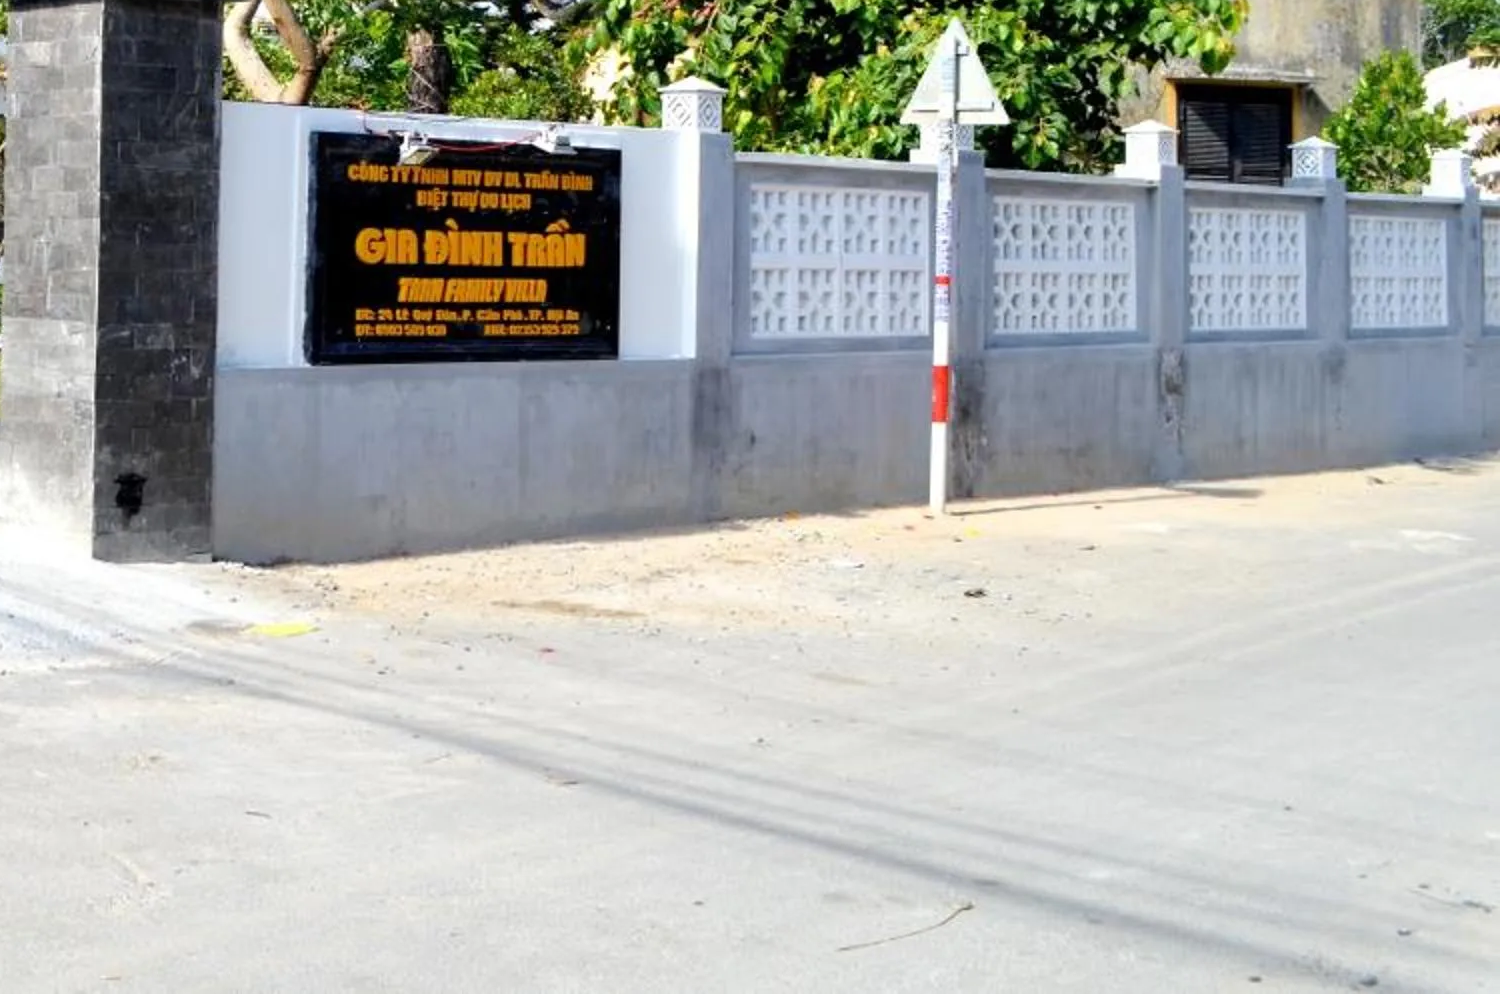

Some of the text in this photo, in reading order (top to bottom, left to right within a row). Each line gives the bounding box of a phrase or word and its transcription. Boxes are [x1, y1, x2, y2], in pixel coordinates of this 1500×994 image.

[355, 218, 586, 267] GIA ĐÌNH TRẦN
